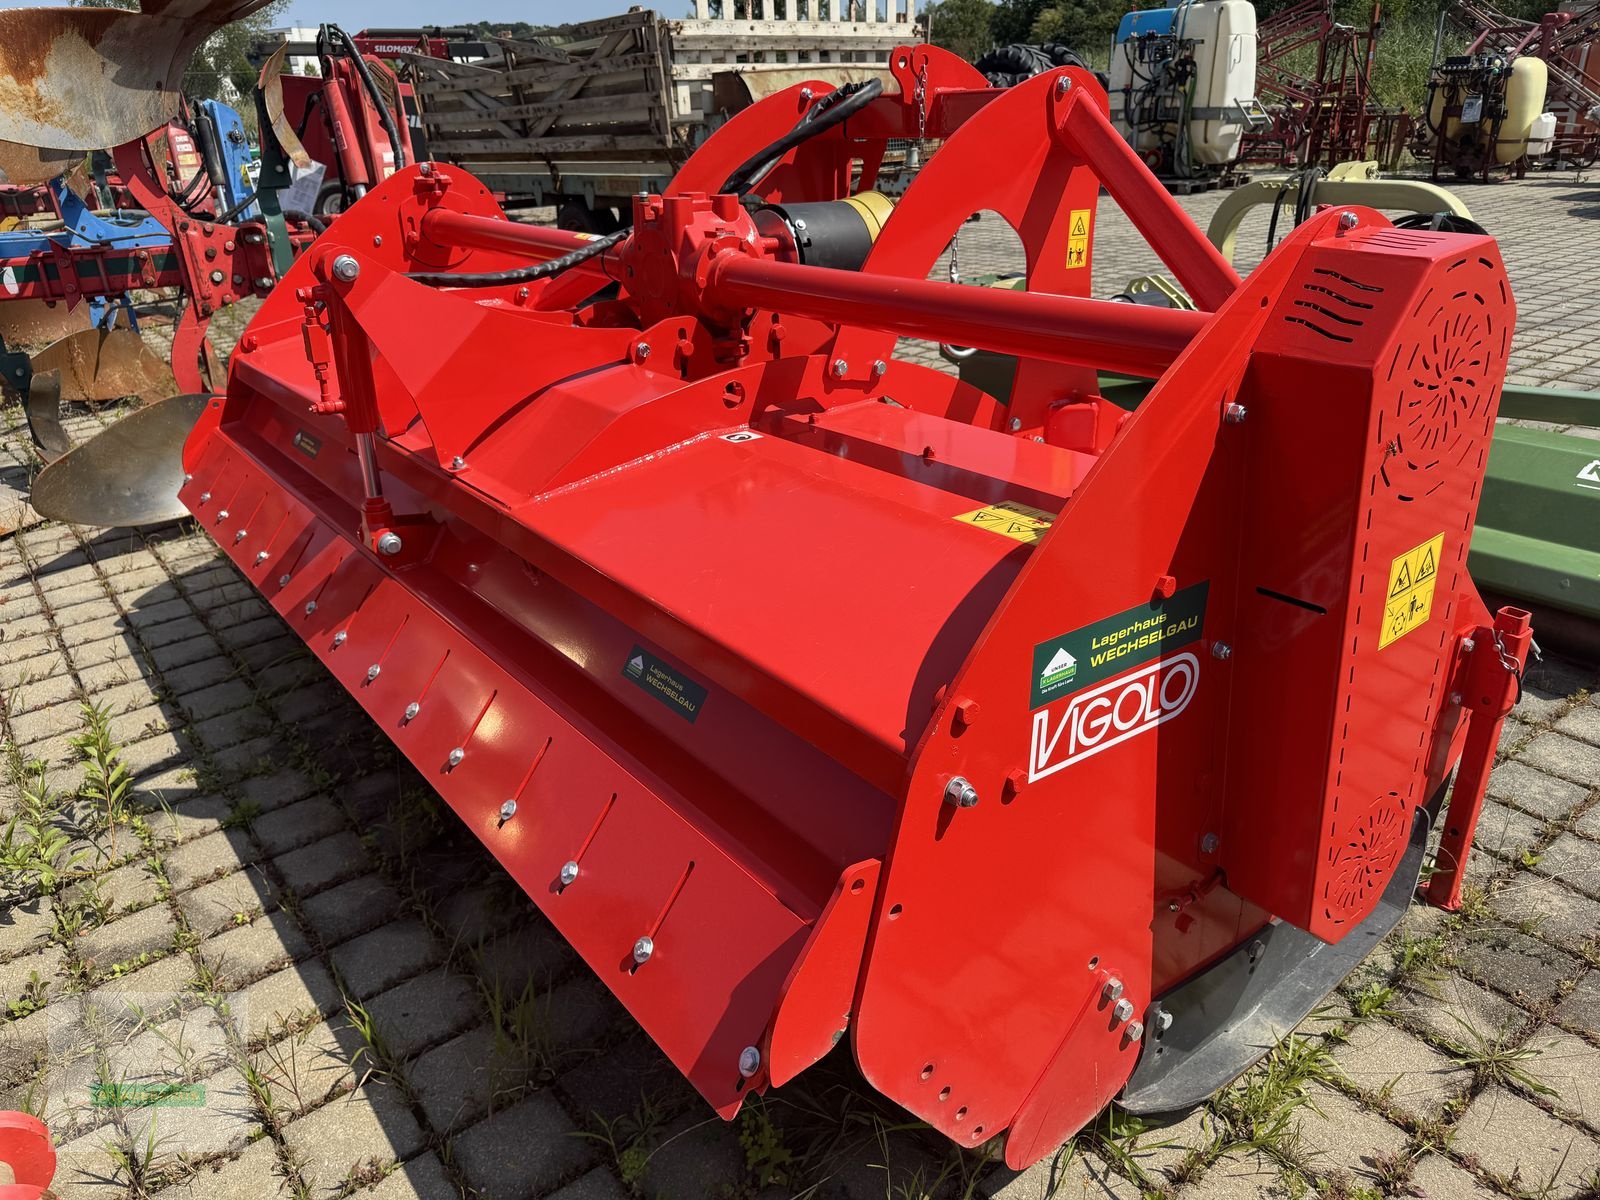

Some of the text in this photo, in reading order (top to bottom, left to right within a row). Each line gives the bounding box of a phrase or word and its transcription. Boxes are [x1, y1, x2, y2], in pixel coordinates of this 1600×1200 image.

[374, 44, 412, 53] SILOMAX
[1090, 615, 1199, 668] WECHSELGAU
[1091, 613, 1168, 650] Lagerhaus
[650, 664, 685, 691] Lagerhaus
[1051, 662, 1067, 672] UNSER
[646, 674, 696, 712] WECHSELGAU
[1035, 661, 1193, 771] VIGOLO
